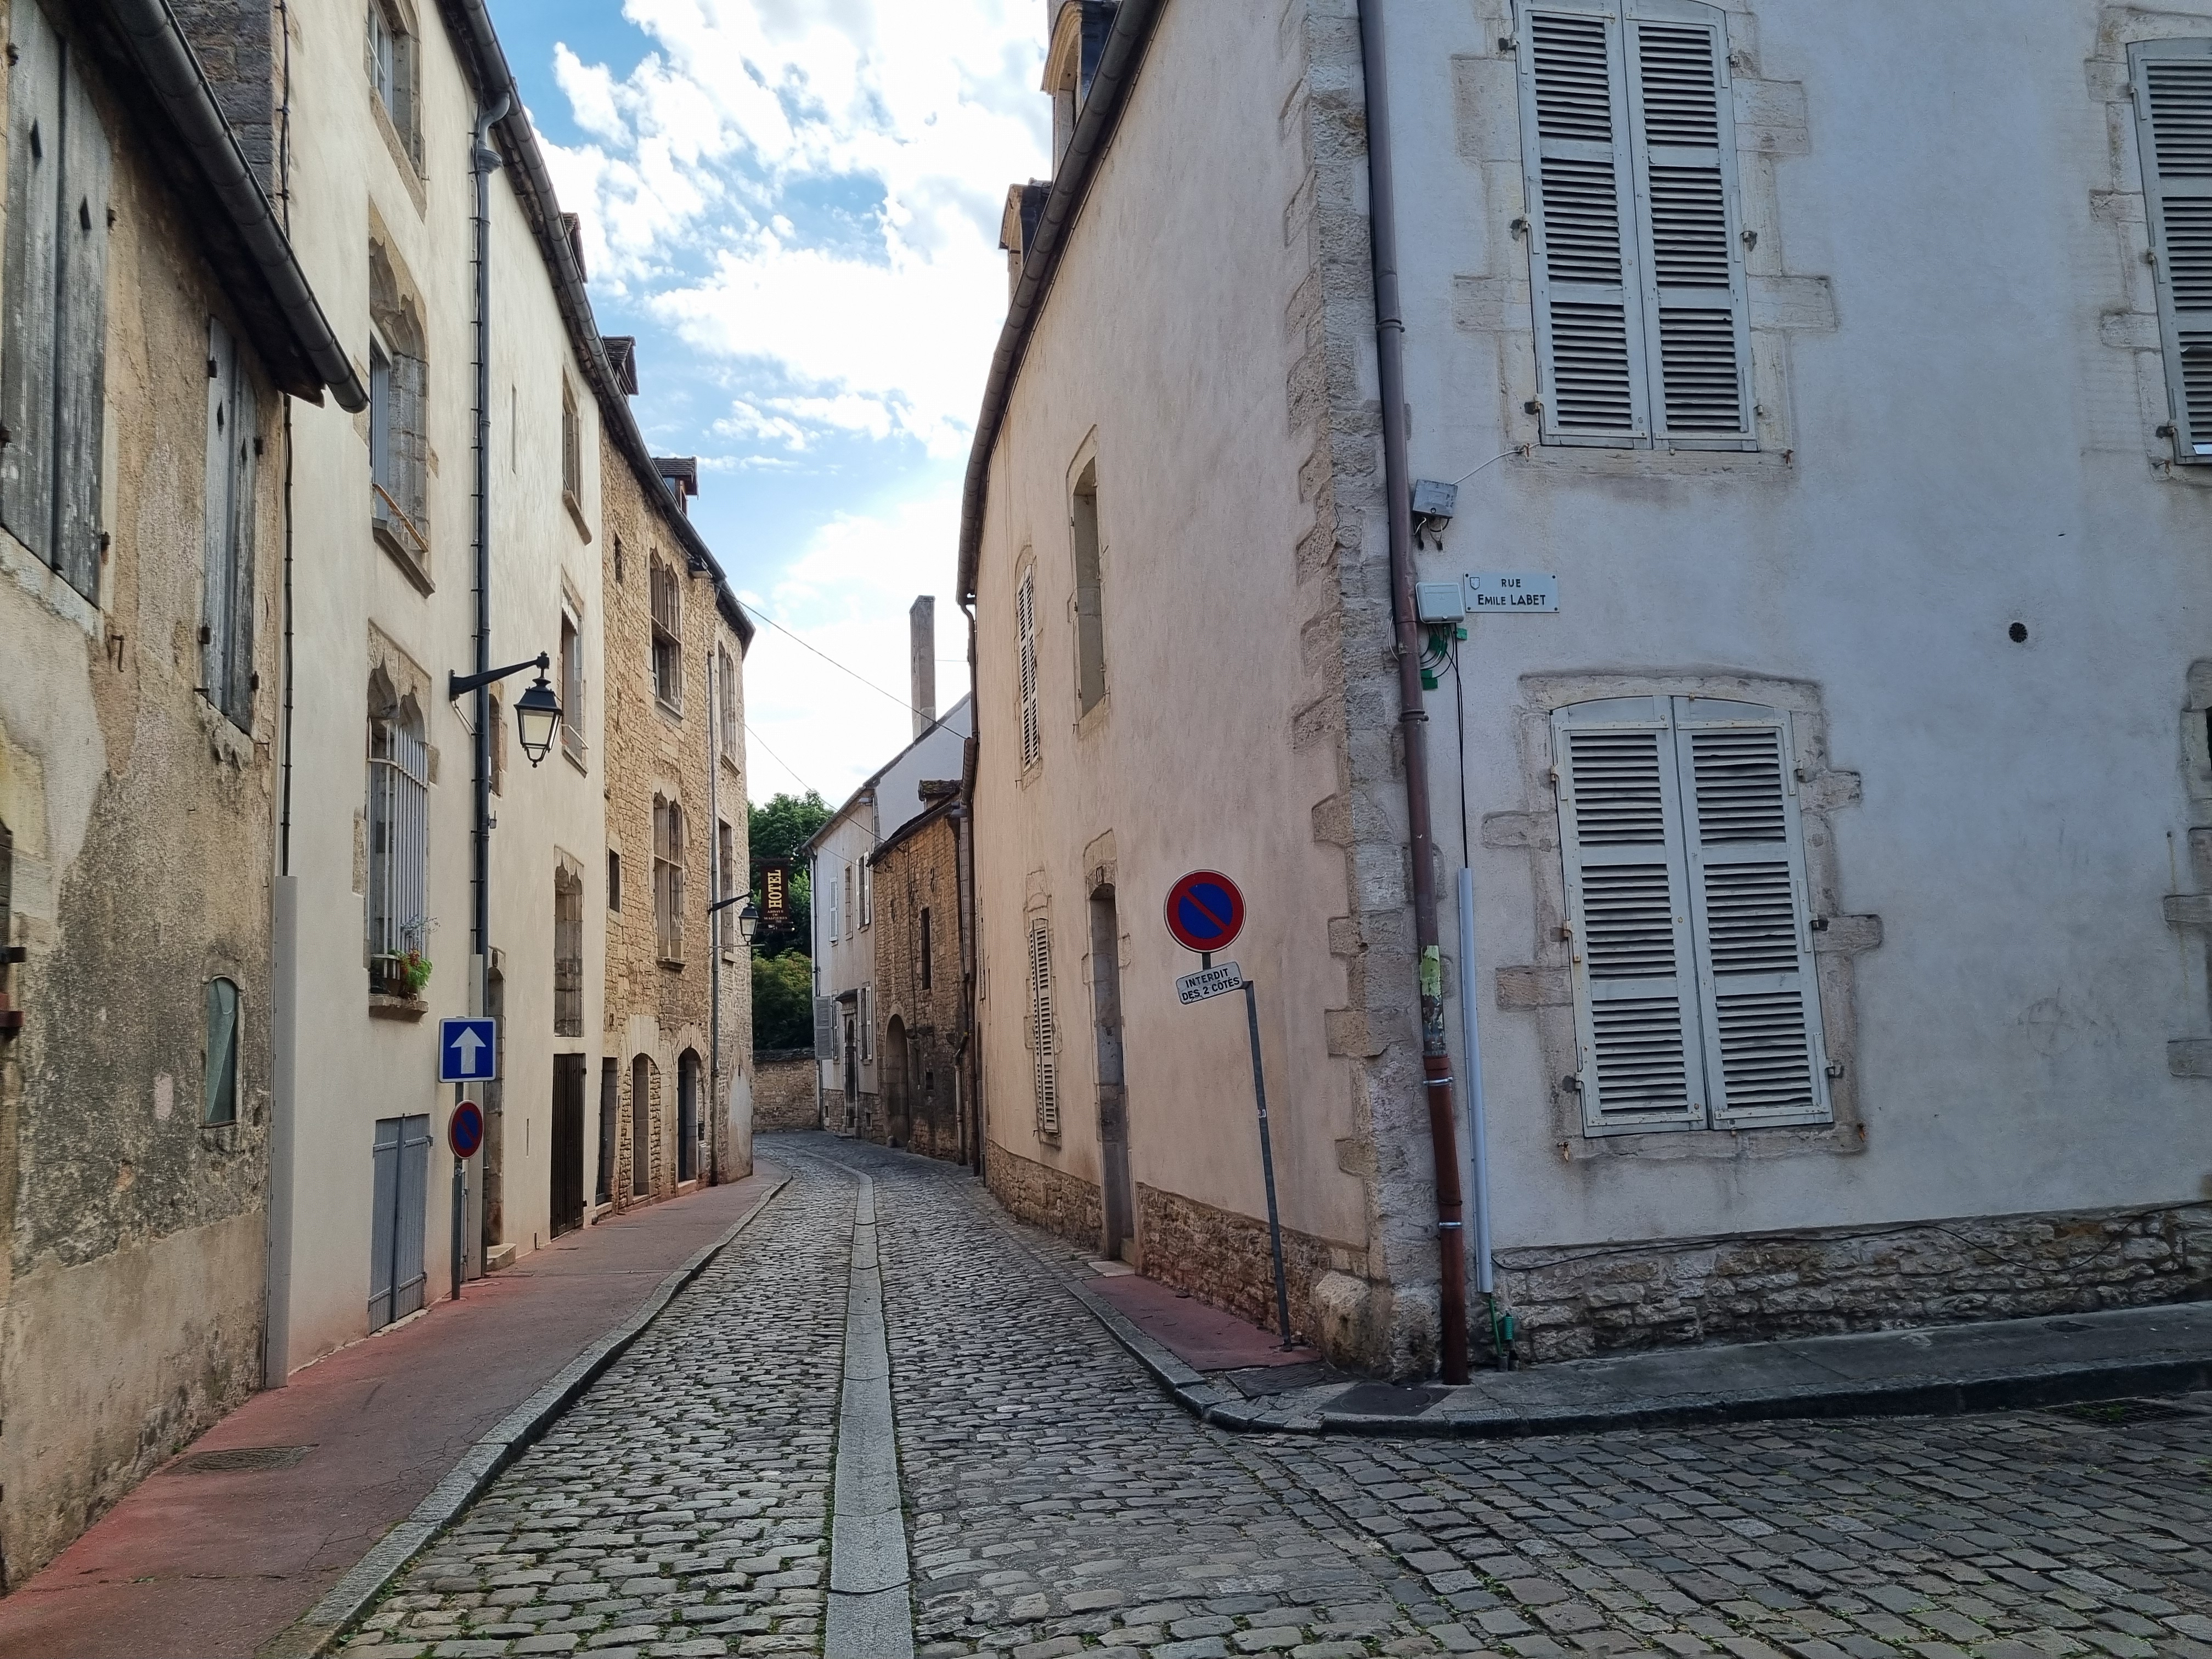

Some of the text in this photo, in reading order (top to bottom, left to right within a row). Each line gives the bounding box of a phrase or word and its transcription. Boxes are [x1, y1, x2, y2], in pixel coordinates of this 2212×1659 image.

[1501, 578, 1521, 588] RUE
[1510, 594, 1546, 606] LABET
[768, 869, 782, 909] HOTEL
[1185, 968, 1228, 988] INTERDIT
[1182, 977, 1240, 1001] DES 2 CÔTÉS
